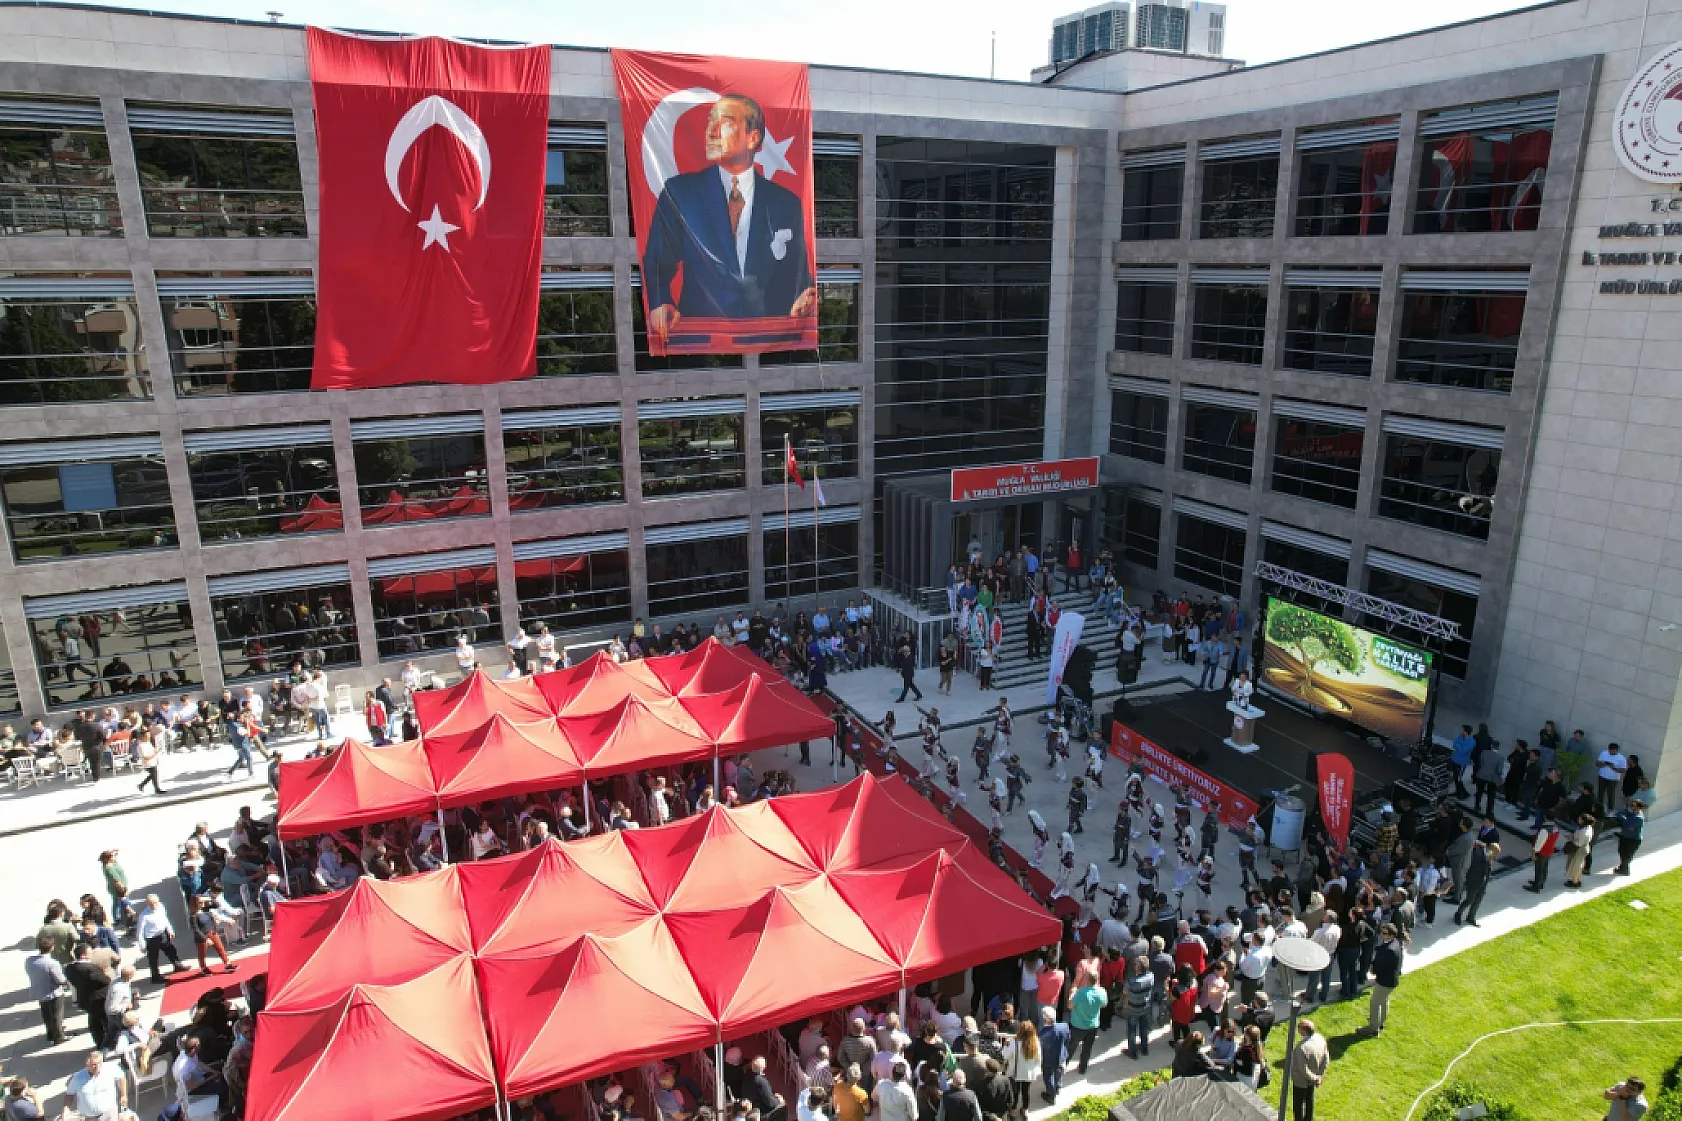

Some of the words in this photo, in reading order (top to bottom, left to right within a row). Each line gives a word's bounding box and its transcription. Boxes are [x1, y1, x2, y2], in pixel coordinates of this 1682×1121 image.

[1599, 221, 1656, 238] MUĞLA
[1598, 252, 1648, 265] TARIM
[1652, 252, 1674, 265] VE
[996, 475, 1026, 487] MUĞLA
[972, 488, 998, 499] TARIM
[1000, 486, 1010, 496] VE
[1011, 483, 1042, 494] ORMAN
[1372, 647, 1425, 674] KALİTE
[1140, 741, 1172, 768] BİRLİKTE
